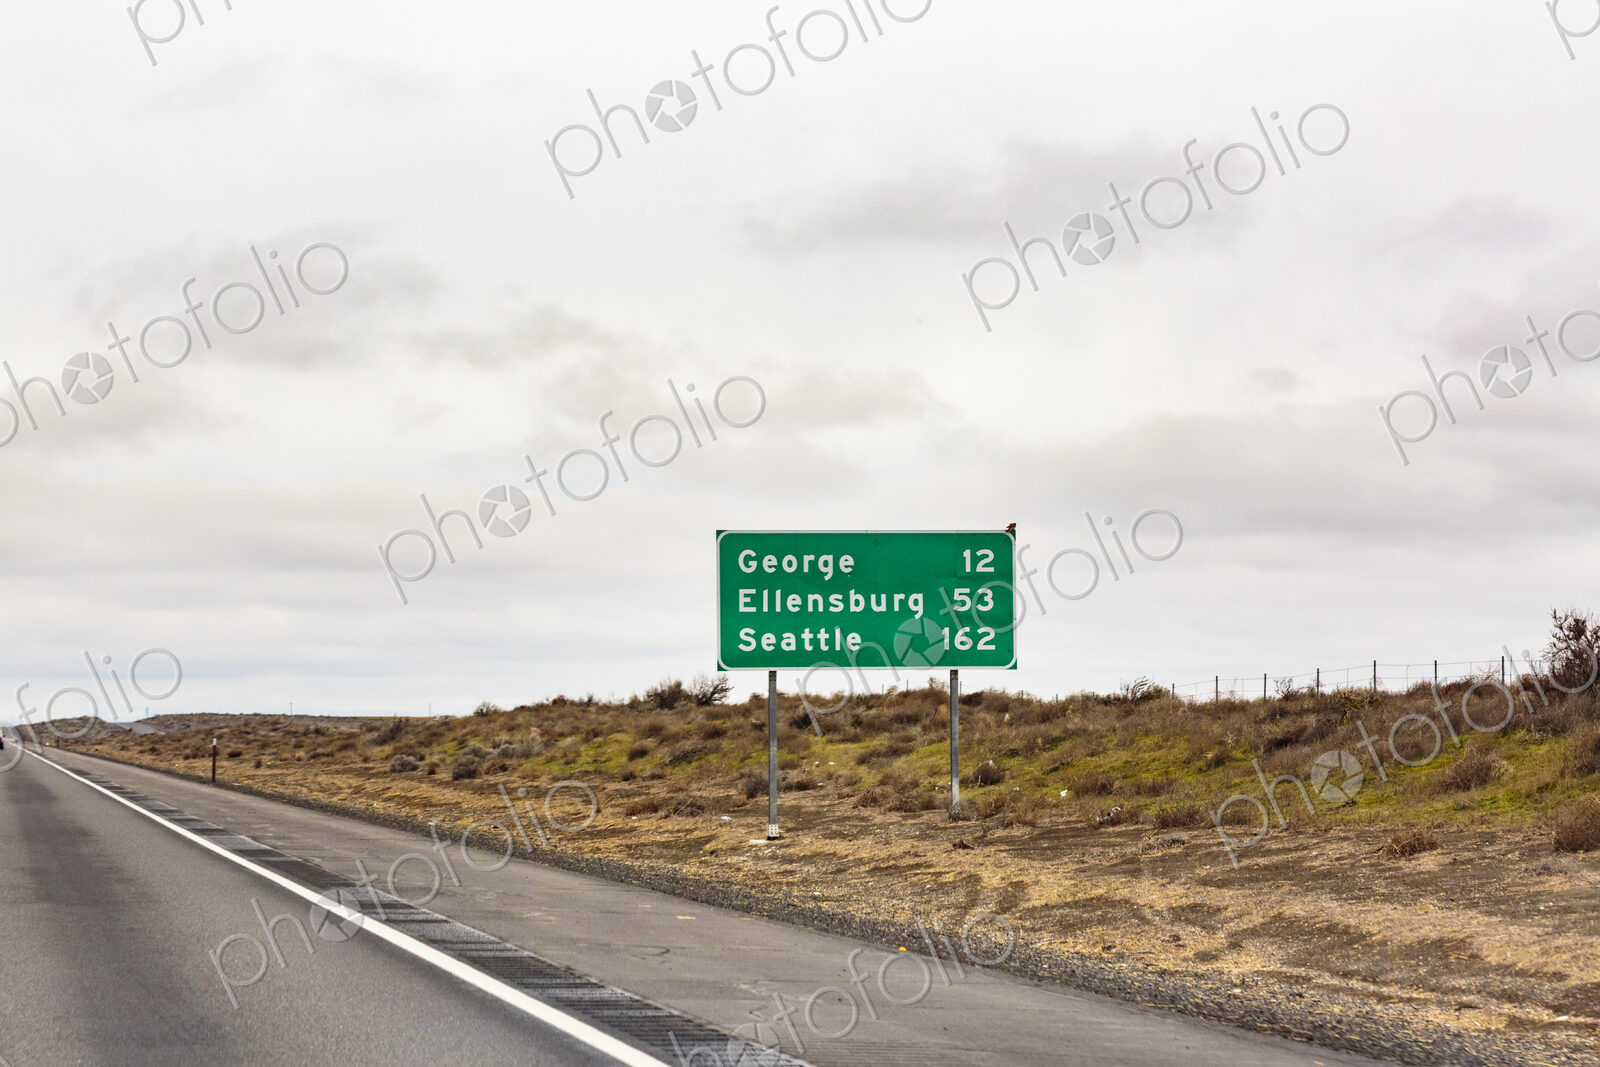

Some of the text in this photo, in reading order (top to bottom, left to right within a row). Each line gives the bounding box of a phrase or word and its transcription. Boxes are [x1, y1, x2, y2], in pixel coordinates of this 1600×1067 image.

[738, 549, 995, 581] George 12
[738, 588, 994, 620] Ellensburg 53
[737, 627, 996, 652] Seattle 162
